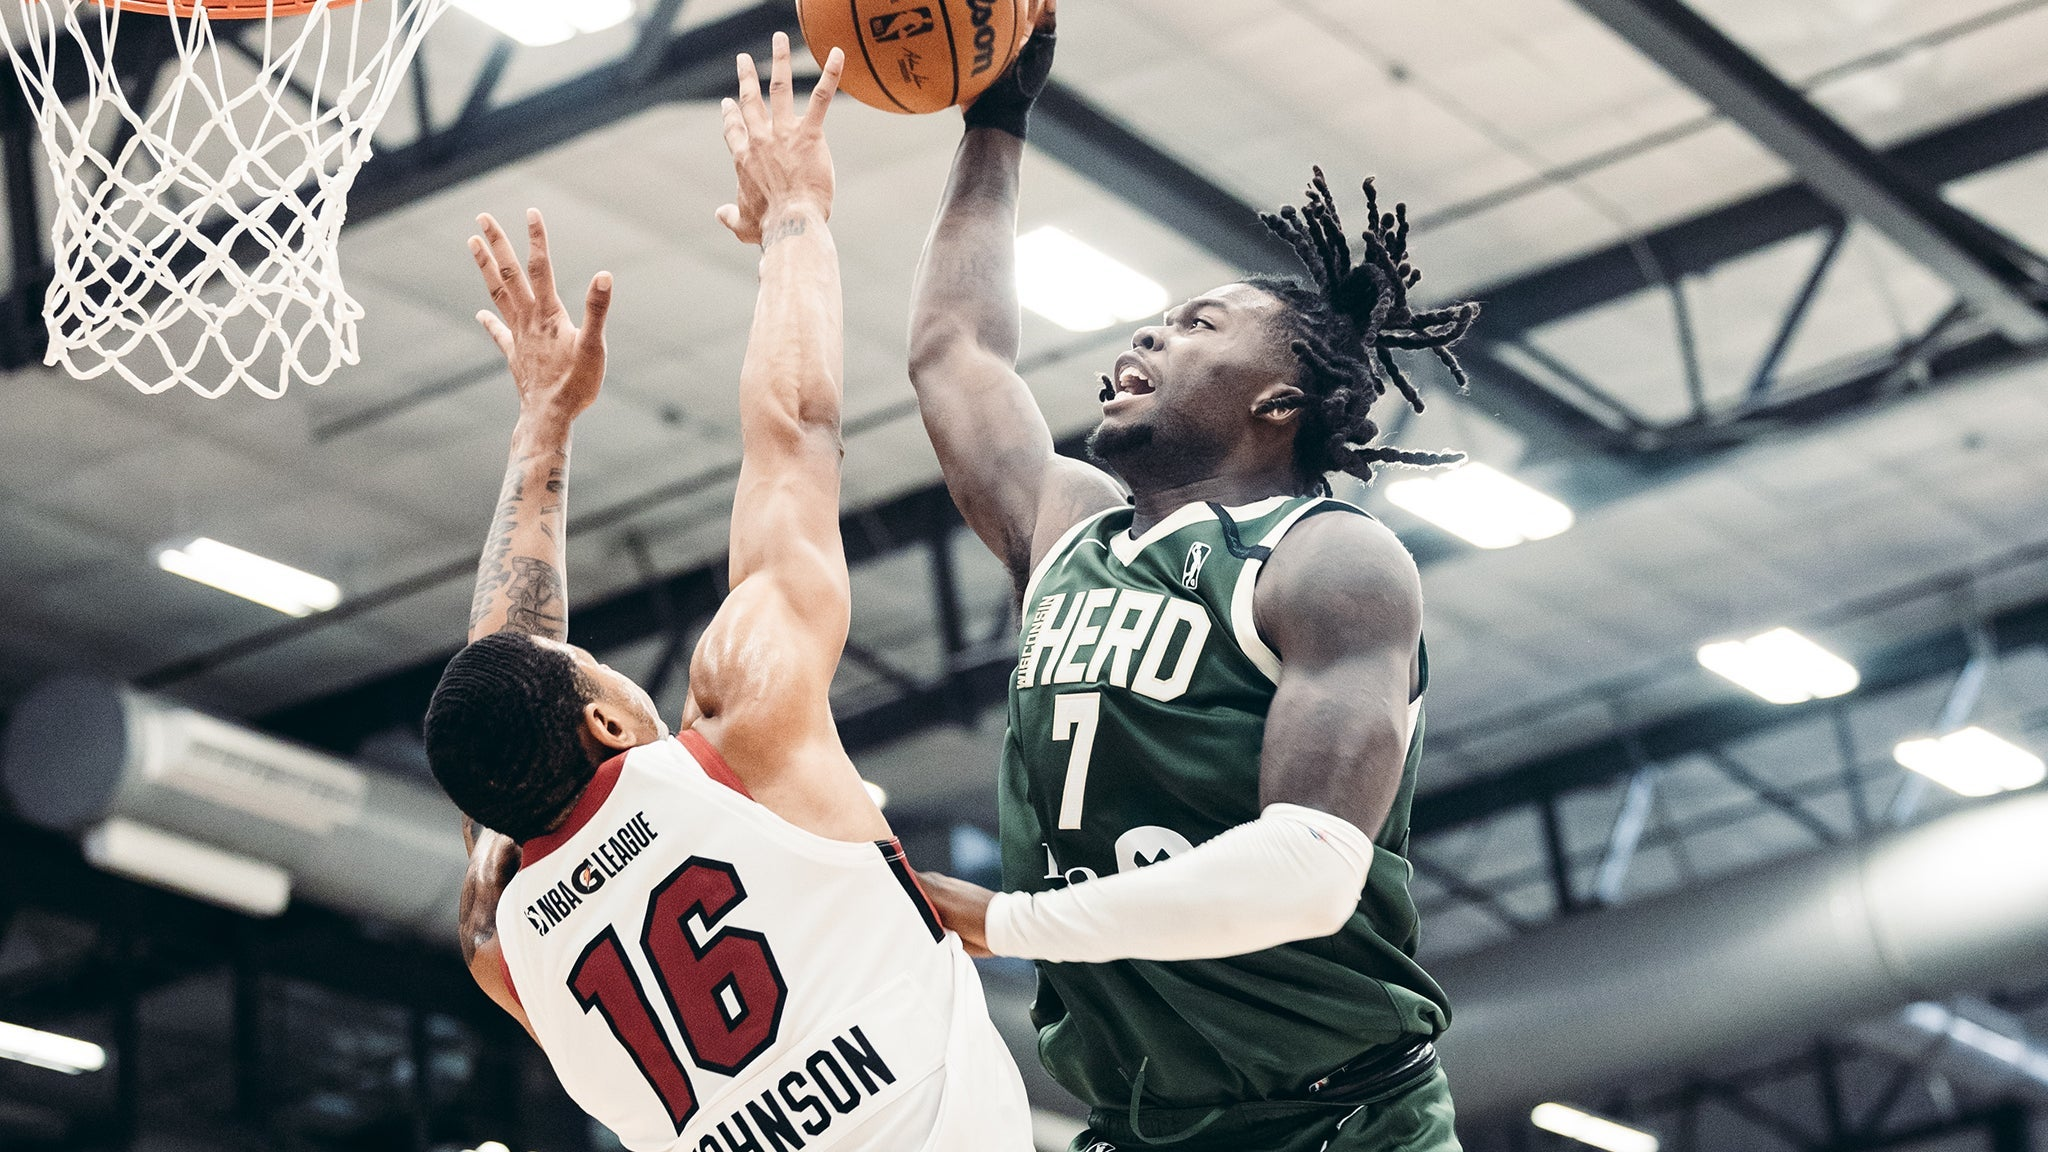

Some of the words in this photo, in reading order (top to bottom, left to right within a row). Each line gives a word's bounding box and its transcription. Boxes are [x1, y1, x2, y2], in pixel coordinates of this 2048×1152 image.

[1016, 596, 1055, 690] WISCONSIN
[1027, 588, 1211, 702] HERD
[1052, 692, 1101, 830] 7
[536, 880, 583, 927] NBA
[571, 858, 606, 895] G
[590, 811, 658, 878] LEAGUE
[566, 855, 788, 1137] 16
